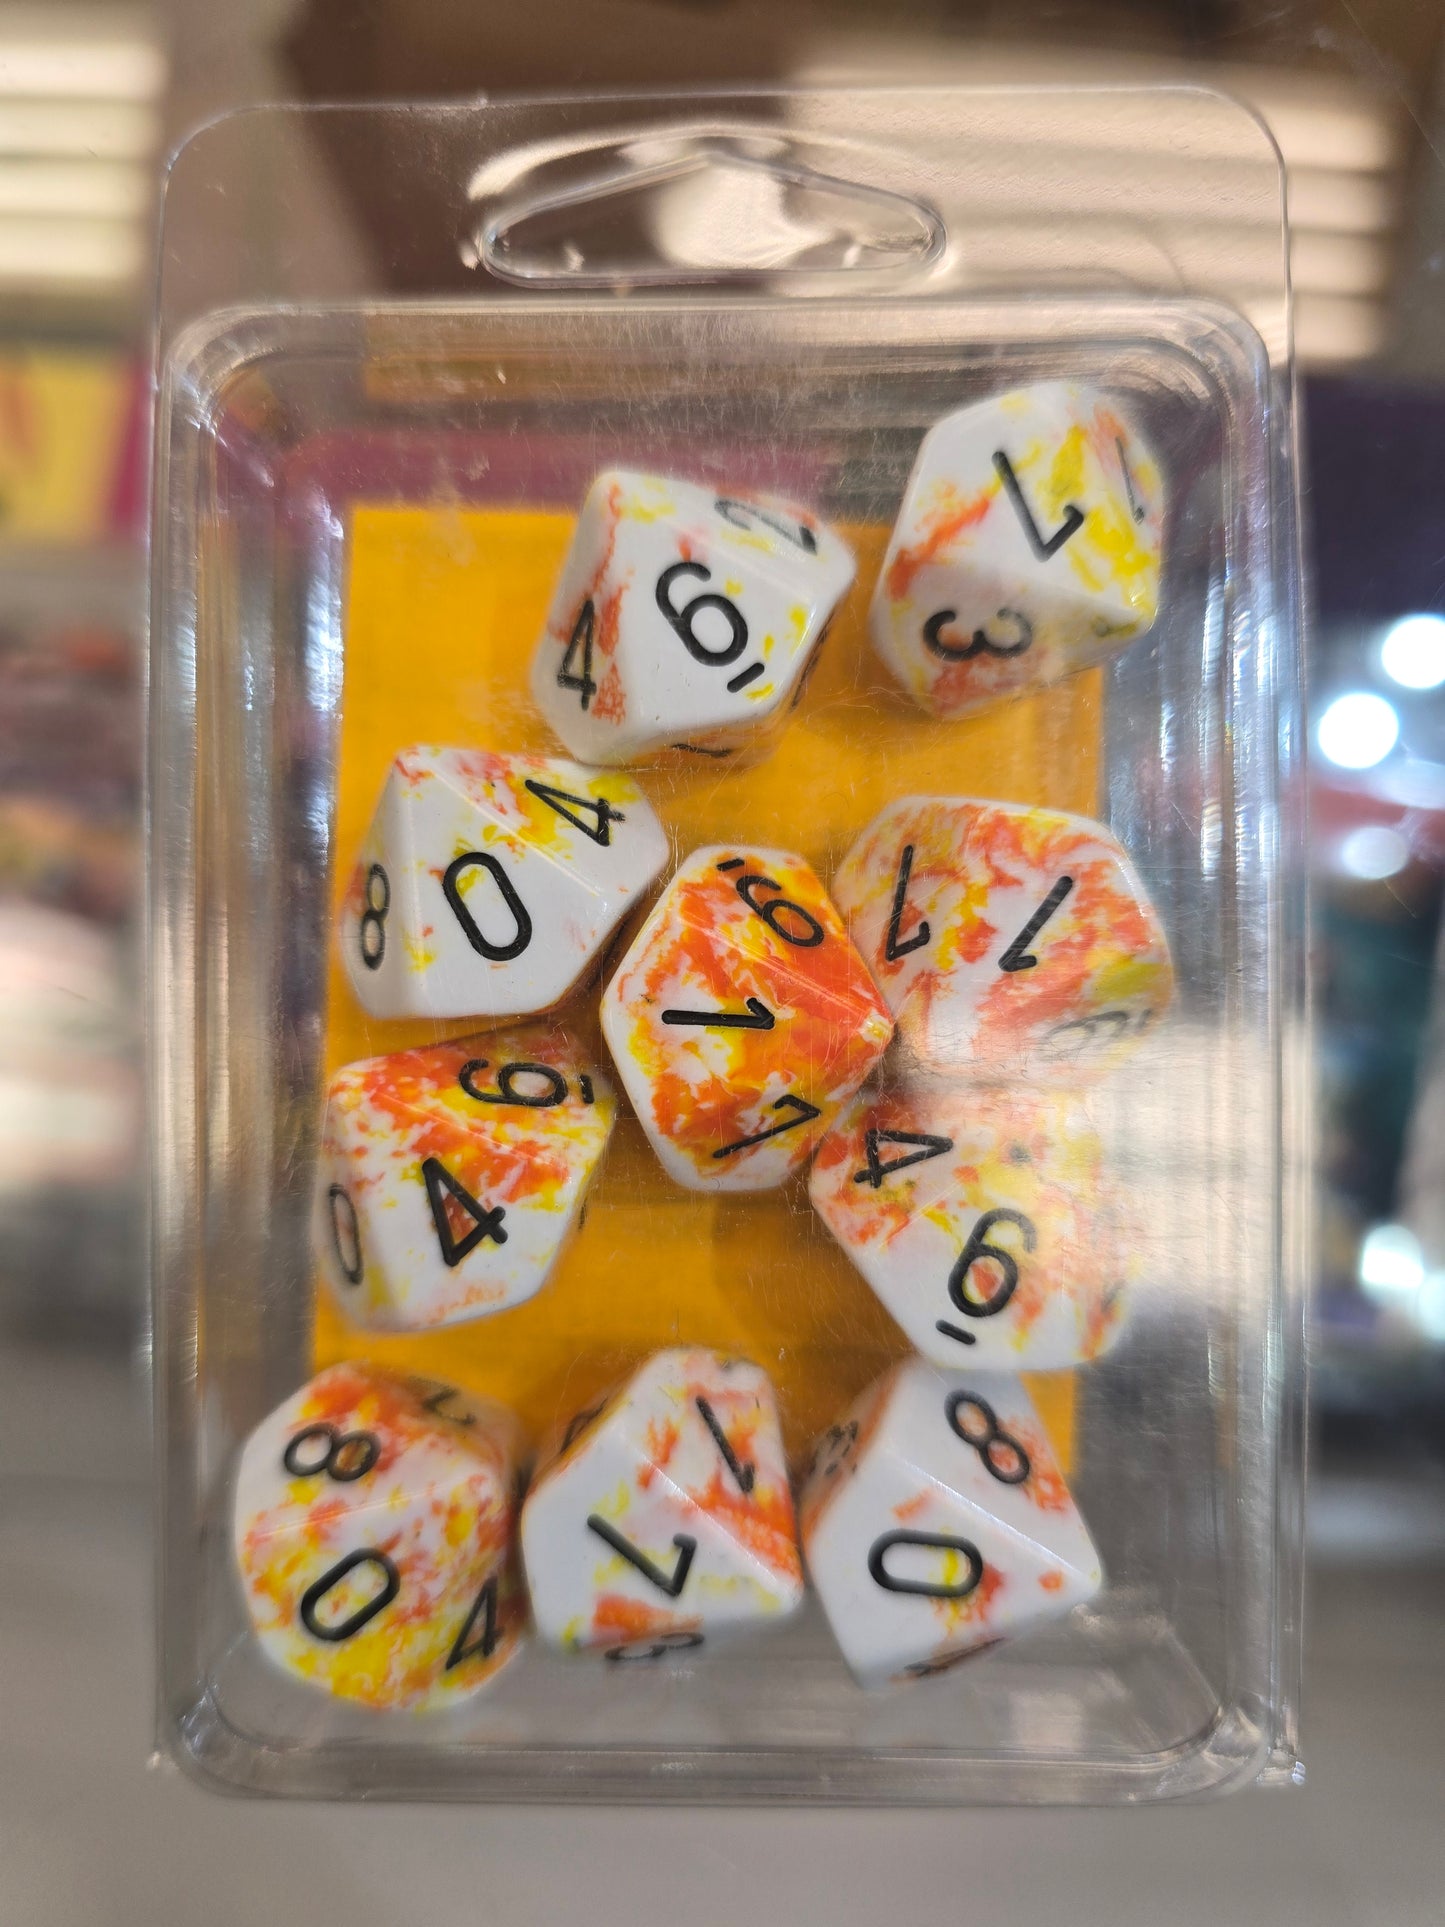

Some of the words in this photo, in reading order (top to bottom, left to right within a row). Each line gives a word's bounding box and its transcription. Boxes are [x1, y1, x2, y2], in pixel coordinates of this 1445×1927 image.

[714, 498, 817, 554] 2
[991, 450, 1084, 562] 7
[557, 593, 597, 711] 4
[656, 561, 765, 692] 6
[923, 610, 1033, 662] 3
[525, 779, 625, 846] 4
[361, 864, 390, 970] 8
[443, 852, 532, 961] 0
[886, 845, 931, 961] 7
[998, 876, 1073, 972] 1
[661, 997, 775, 1030] 1
[458, 1059, 595, 1107] 6
[712, 1094, 822, 1159] 7
[853, 1128, 954, 1188] 4
[328, 1183, 364, 1285] 0
[422, 1158, 508, 1267] 4
[935, 1208, 1038, 1345] 6
[284, 1422, 382, 1482] 8
[696, 1396, 755, 1493] 1
[944, 1389, 1030, 1484] 8
[301, 1548, 399, 1641] 0
[587, 1513, 697, 1597] 7
[868, 1529, 983, 1597] 0
[445, 1574, 505, 1671] 4
